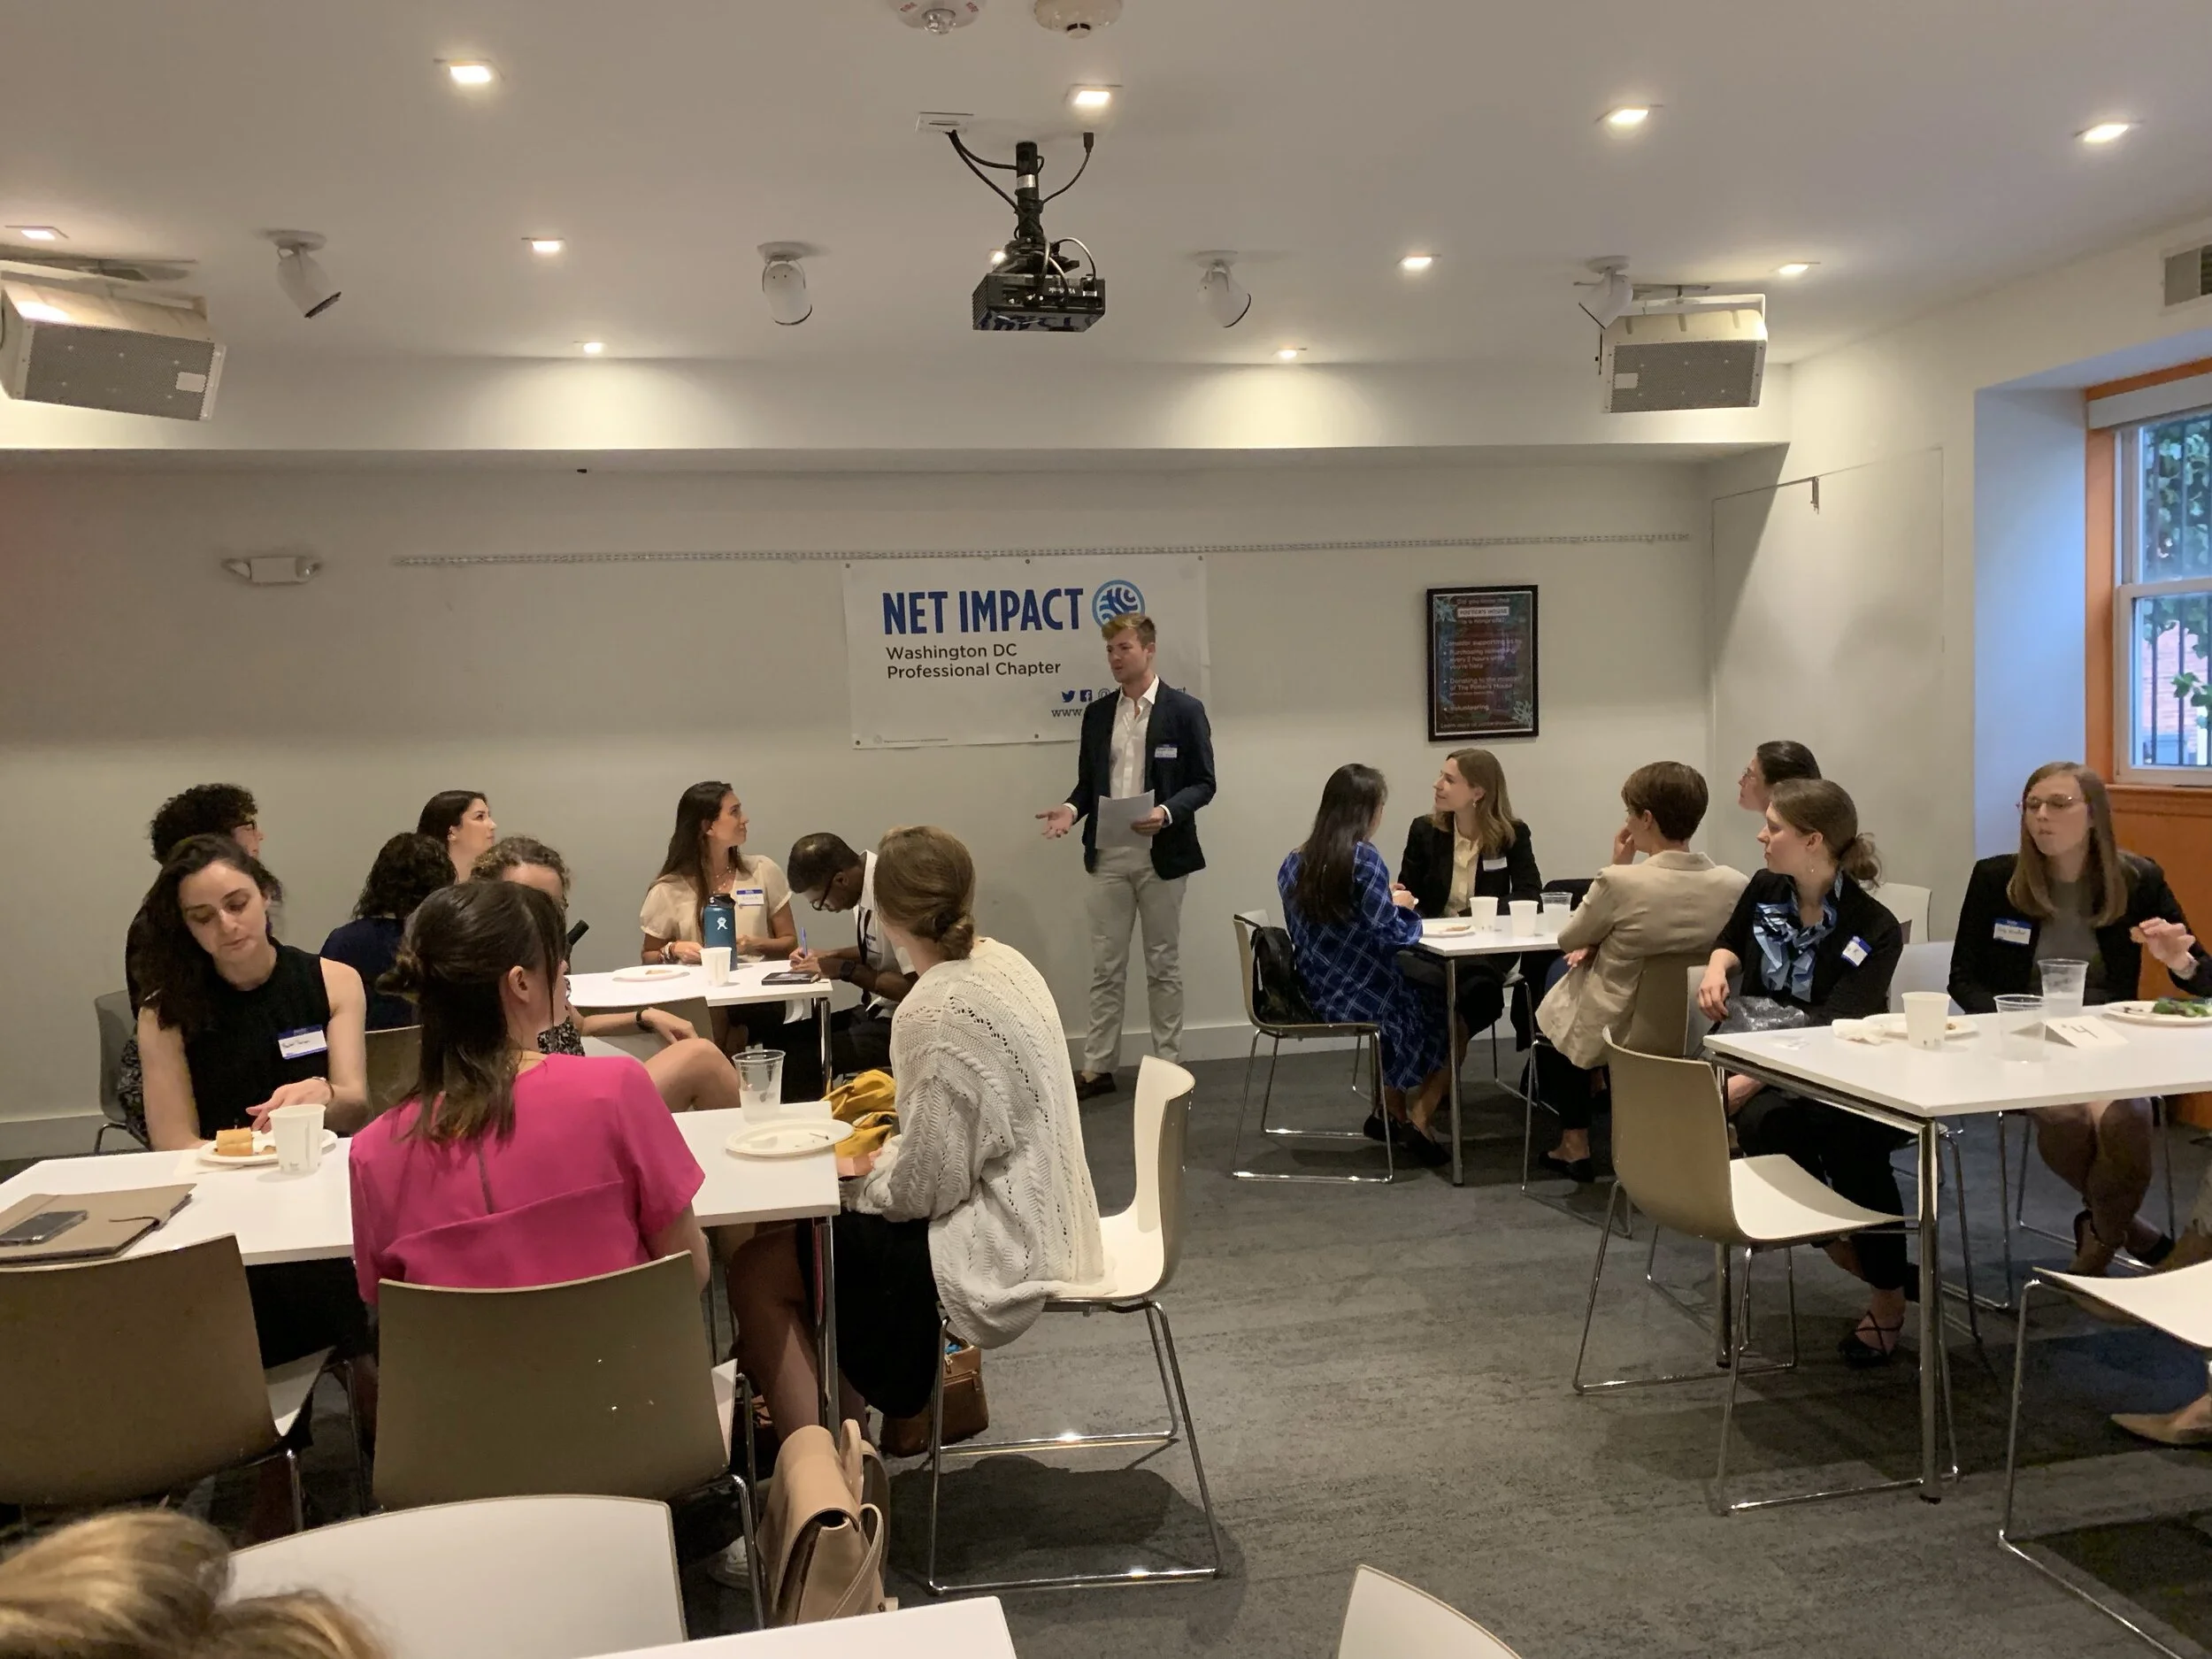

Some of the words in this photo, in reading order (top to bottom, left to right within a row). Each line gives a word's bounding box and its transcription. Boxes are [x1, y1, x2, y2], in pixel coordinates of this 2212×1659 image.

[882, 591, 948, 634] NET
[959, 588, 1083, 633] IMPACT
[887, 645, 987, 660] Washington
[994, 643, 1017, 657] DC
[887, 663, 989, 679] Professional
[995, 662, 1061, 677] Chapter
